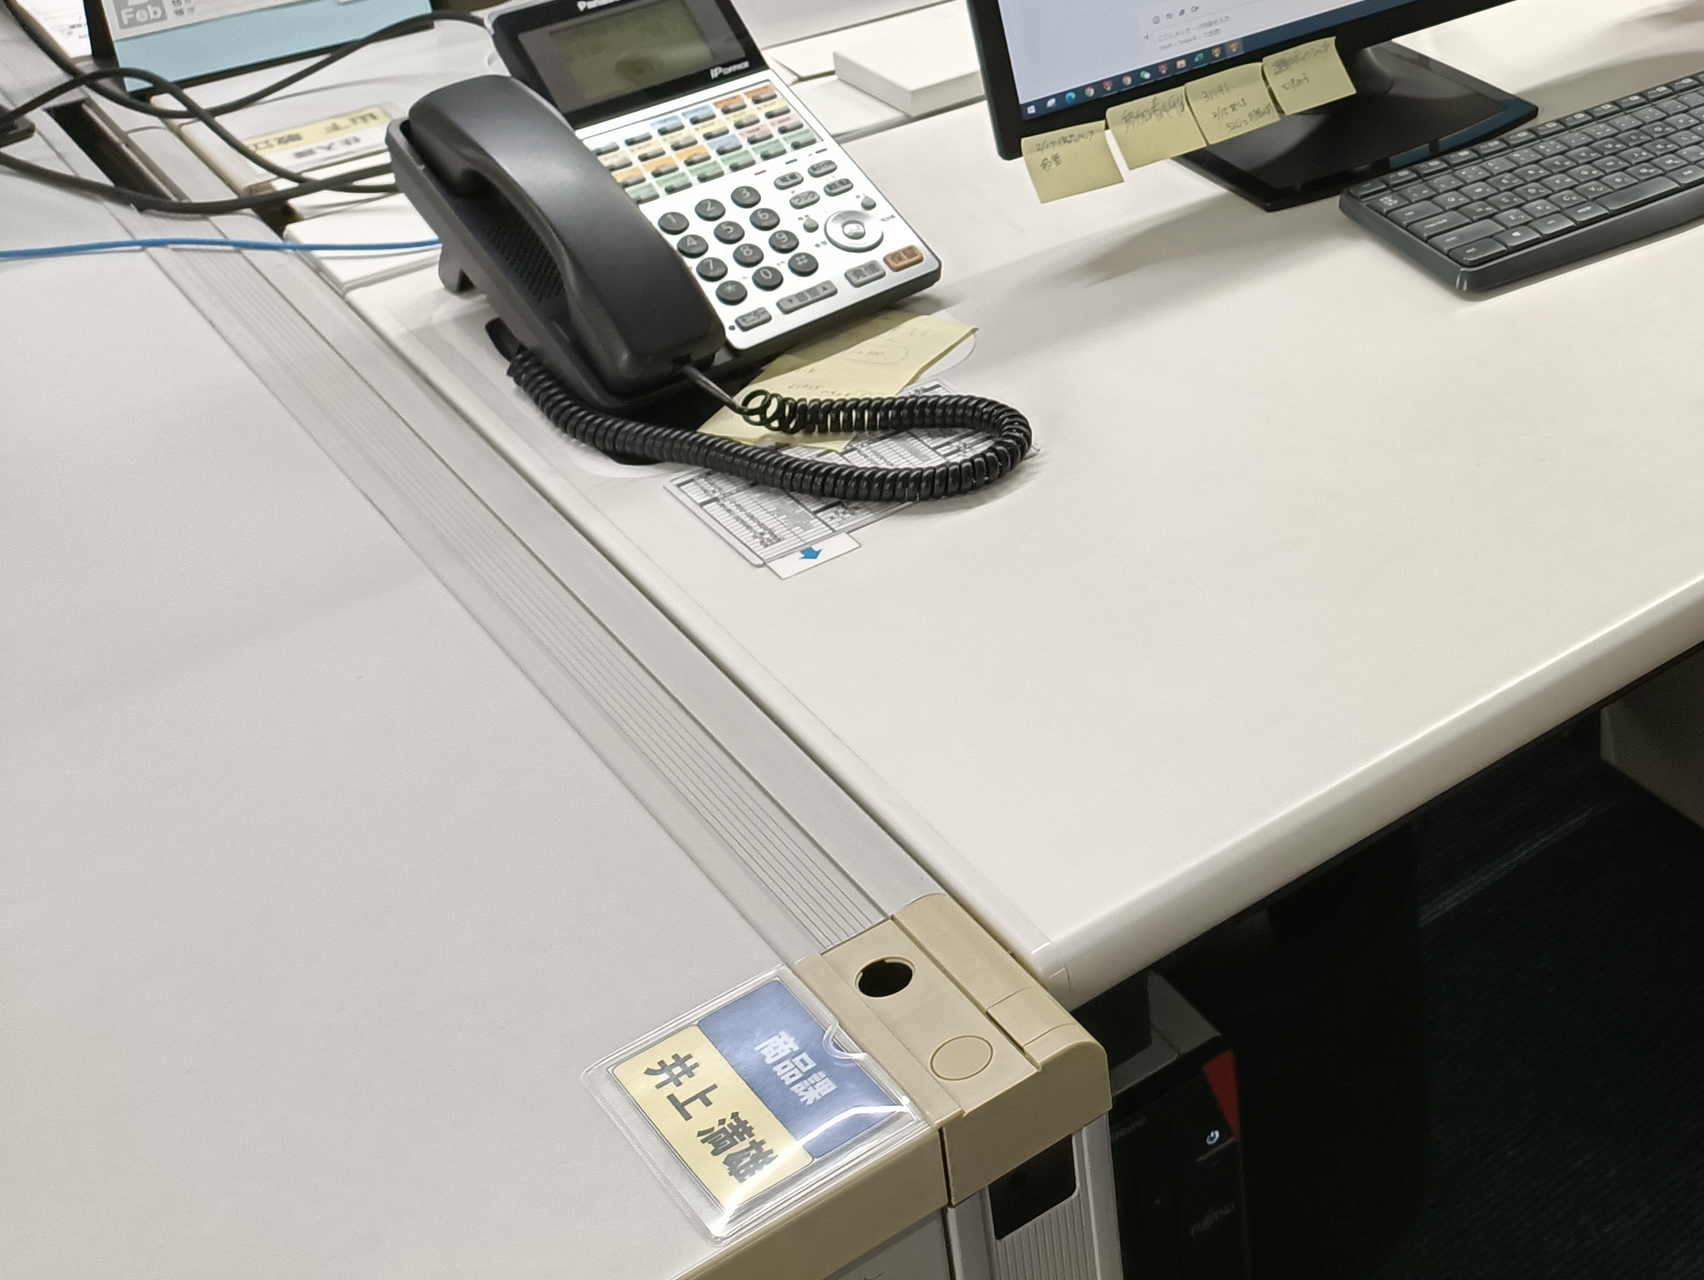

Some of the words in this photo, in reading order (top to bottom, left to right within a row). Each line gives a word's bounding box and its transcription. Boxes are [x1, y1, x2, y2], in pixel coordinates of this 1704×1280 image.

[120, 4, 163, 26] Feb
[325, 112, 378, 133] 山下
[644, 1052, 719, 1123] 井上
[754, 1030, 837, 1107] 商品課
